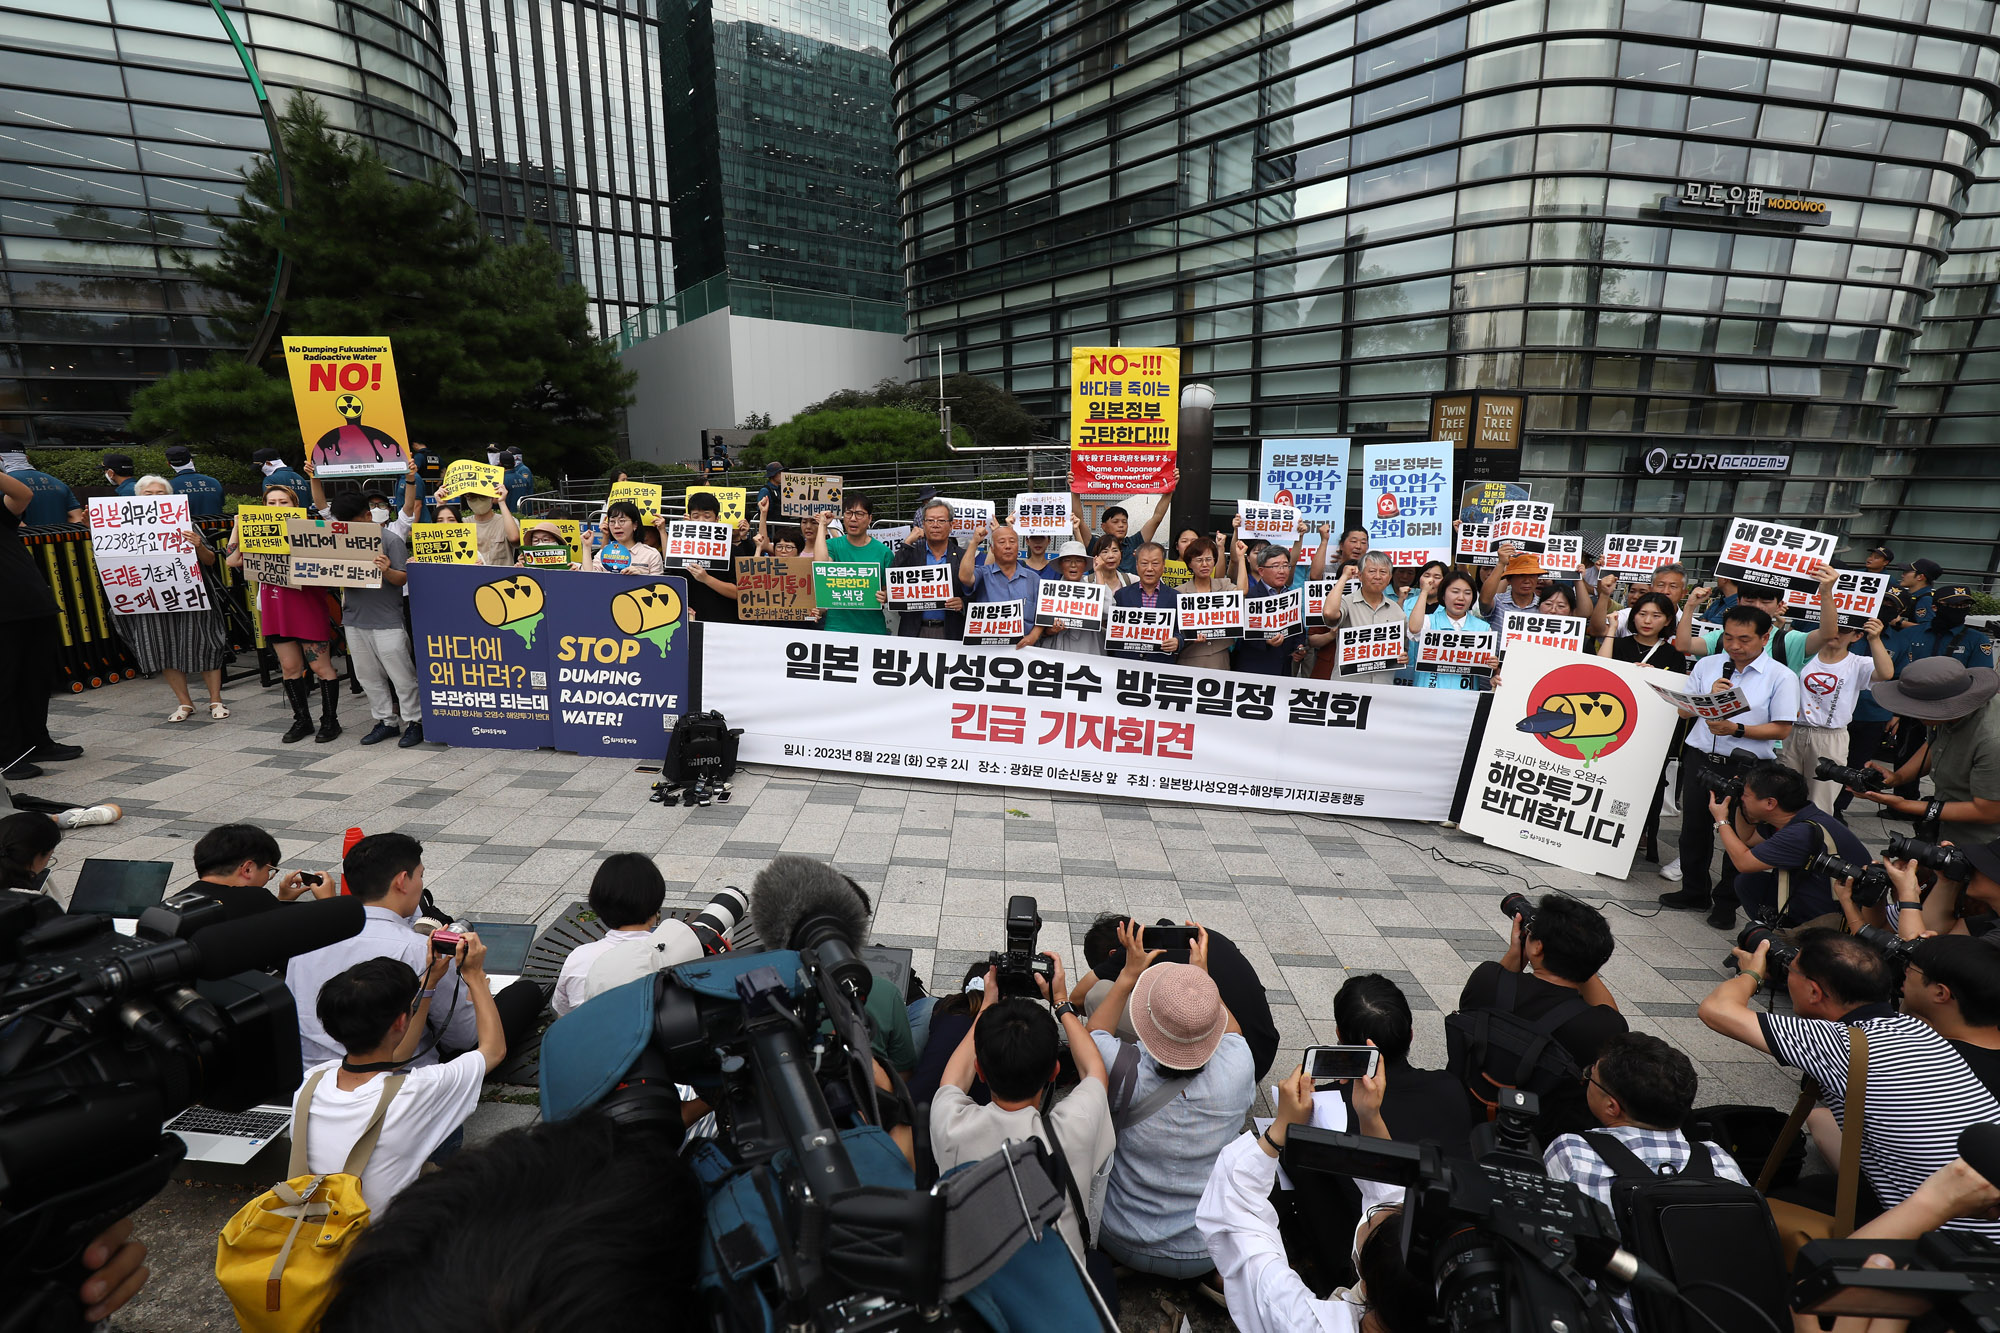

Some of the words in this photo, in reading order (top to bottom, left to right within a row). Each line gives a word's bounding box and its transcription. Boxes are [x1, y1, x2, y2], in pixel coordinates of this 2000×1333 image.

[1682, 182, 1745, 214] 모도우
[1768, 198, 1826, 213] MODOWOO
[309, 362, 382, 392] NO!
[1080, 381, 1122, 396] 바다를
[1128, 381, 1170, 396] 죽이는
[1089, 402, 1160, 420] 일본정부
[1080, 426, 1170, 444] 규탄한다!!!
[1272, 454, 1298, 467] 일본
[1300, 454, 1339, 466] 정부는
[1374, 458, 1400, 471] 일본
[1403, 456, 1443, 470] 정부는
[1673, 454, 1718, 470] GDR
[1722, 457, 1786, 468] ACADEMY
[1124, 466, 1162, 474] Japanese
[1087, 482, 1110, 490] Killing
[1267, 470, 1342, 491] 핵오염수
[1369, 472, 1446, 494] 핵오염수
[634, 488, 656, 496] 오염수
[718, 492, 740, 500] 오염수
[783, 503, 812, 516] 바다에
[1020, 504, 1066, 516] 방류결정
[1295, 494, 1332, 514] 방류
[1400, 496, 1438, 517] 방류
[1495, 504, 1548, 521] 방류일정
[242, 514, 273, 523] 후쿠시마
[1020, 516, 1066, 528] 철회하라
[1246, 508, 1294, 520] 방류결정
[243, 524, 282, 537] 해양투기
[414, 530, 444, 541] 후쿠시마
[446, 528, 471, 538] 오염수
[672, 524, 728, 540] 방류일정
[1244, 520, 1293, 532] 철회하라
[1493, 521, 1545, 538] 철회하라
[244, 538, 261, 548] 절대
[262, 538, 282, 548] 안돼!
[290, 534, 336, 550] 바다에
[346, 536, 382, 551] 버려?
[1608, 536, 1677, 555] 해양투기
[1734, 522, 1830, 556] 해양투기
[416, 542, 452, 554] 해양투기
[670, 540, 727, 557] 철회하라
[244, 558, 260, 570] THE
[739, 558, 788, 576] 바다는
[1606, 554, 1674, 568] 결사반대
[1726, 542, 1822, 576] 결사반대
[101, 565, 142, 588] 트리튬
[141, 562, 178, 582] 기준치
[294, 562, 344, 578] 보관하면
[858, 568, 878, 578] 투기
[890, 567, 948, 584] 해양투기
[258, 572, 288, 586] OCEAN
[738, 574, 812, 595] 쓰레기통이
[741, 590, 797, 607] 아니다!
[832, 590, 864, 602] 녹색당
[890, 584, 950, 600] 결사반대
[1042, 582, 1100, 601] 해양투기
[971, 603, 1022, 619] 해양투기
[1041, 598, 1098, 617] 결사반대
[1181, 595, 1240, 610] 해양투기
[1248, 592, 1299, 614] 해양투기
[1112, 610, 1172, 626] 해양투기
[1182, 610, 1240, 626] 결사반대
[1248, 608, 1298, 628] 결사반대
[1508, 615, 1580, 636] 해양투기
[968, 620, 1022, 634] 결사반대
[1110, 625, 1170, 641] 결사반대
[1344, 624, 1401, 645] 방류일정
[427, 634, 502, 662] 바다에
[1424, 632, 1493, 650] 해양투기
[558, 636, 640, 664] STOP
[1343, 642, 1402, 662] 철회하라
[1422, 648, 1490, 665] 결사반대
[429, 662, 455, 686] 왜
[461, 664, 526, 689] 버려?
[558, 668, 642, 686] DUMPING
[785, 642, 860, 684] 일본
[872, 648, 1102, 702] 방사성오염수
[1116, 669, 1276, 722] 방류일정
[1288, 688, 1372, 730] 철회
[431, 690, 496, 708] 보관하면
[500, 692, 550, 712] 되는데
[560, 689, 678, 709] RADIOACTIVE
[432, 709, 460, 718] 후쿠시마
[462, 710, 482, 718] 방사능
[484, 710, 505, 720] 오염수
[506, 711, 535, 721] 해양투기
[536, 712, 550, 721] 반대
[562, 710, 624, 726] WATER!
[951, 702, 1027, 744] 긴급
[1038, 710, 1196, 760] 기자회견
[784, 744, 806, 757] 일시
[814, 746, 852, 762] 2023년
[855, 750, 872, 763] 8월
[876, 752, 901, 766] 22일
[904, 754, 923, 768] (화)
[926, 756, 948, 770] 오후
[951, 758, 968, 772] 2시
[978, 760, 1000, 774] 장소
[1010, 762, 1044, 778] 광화문
[1046, 764, 1104, 784] 이순신동상
[1106, 771, 1118, 786] 앞
[1127, 773, 1149, 788] 주최
[1159, 776, 1366, 806] 일본방사성오염수해양투기저지공동행동
[1494, 748, 1536, 768] 후쿠시마
[1539, 759, 1570, 777] 방사능
[1573, 769, 1608, 785] 오염수
[1488, 762, 1604, 813] 해양투기
[1480, 786, 1625, 848] 반대합니다
